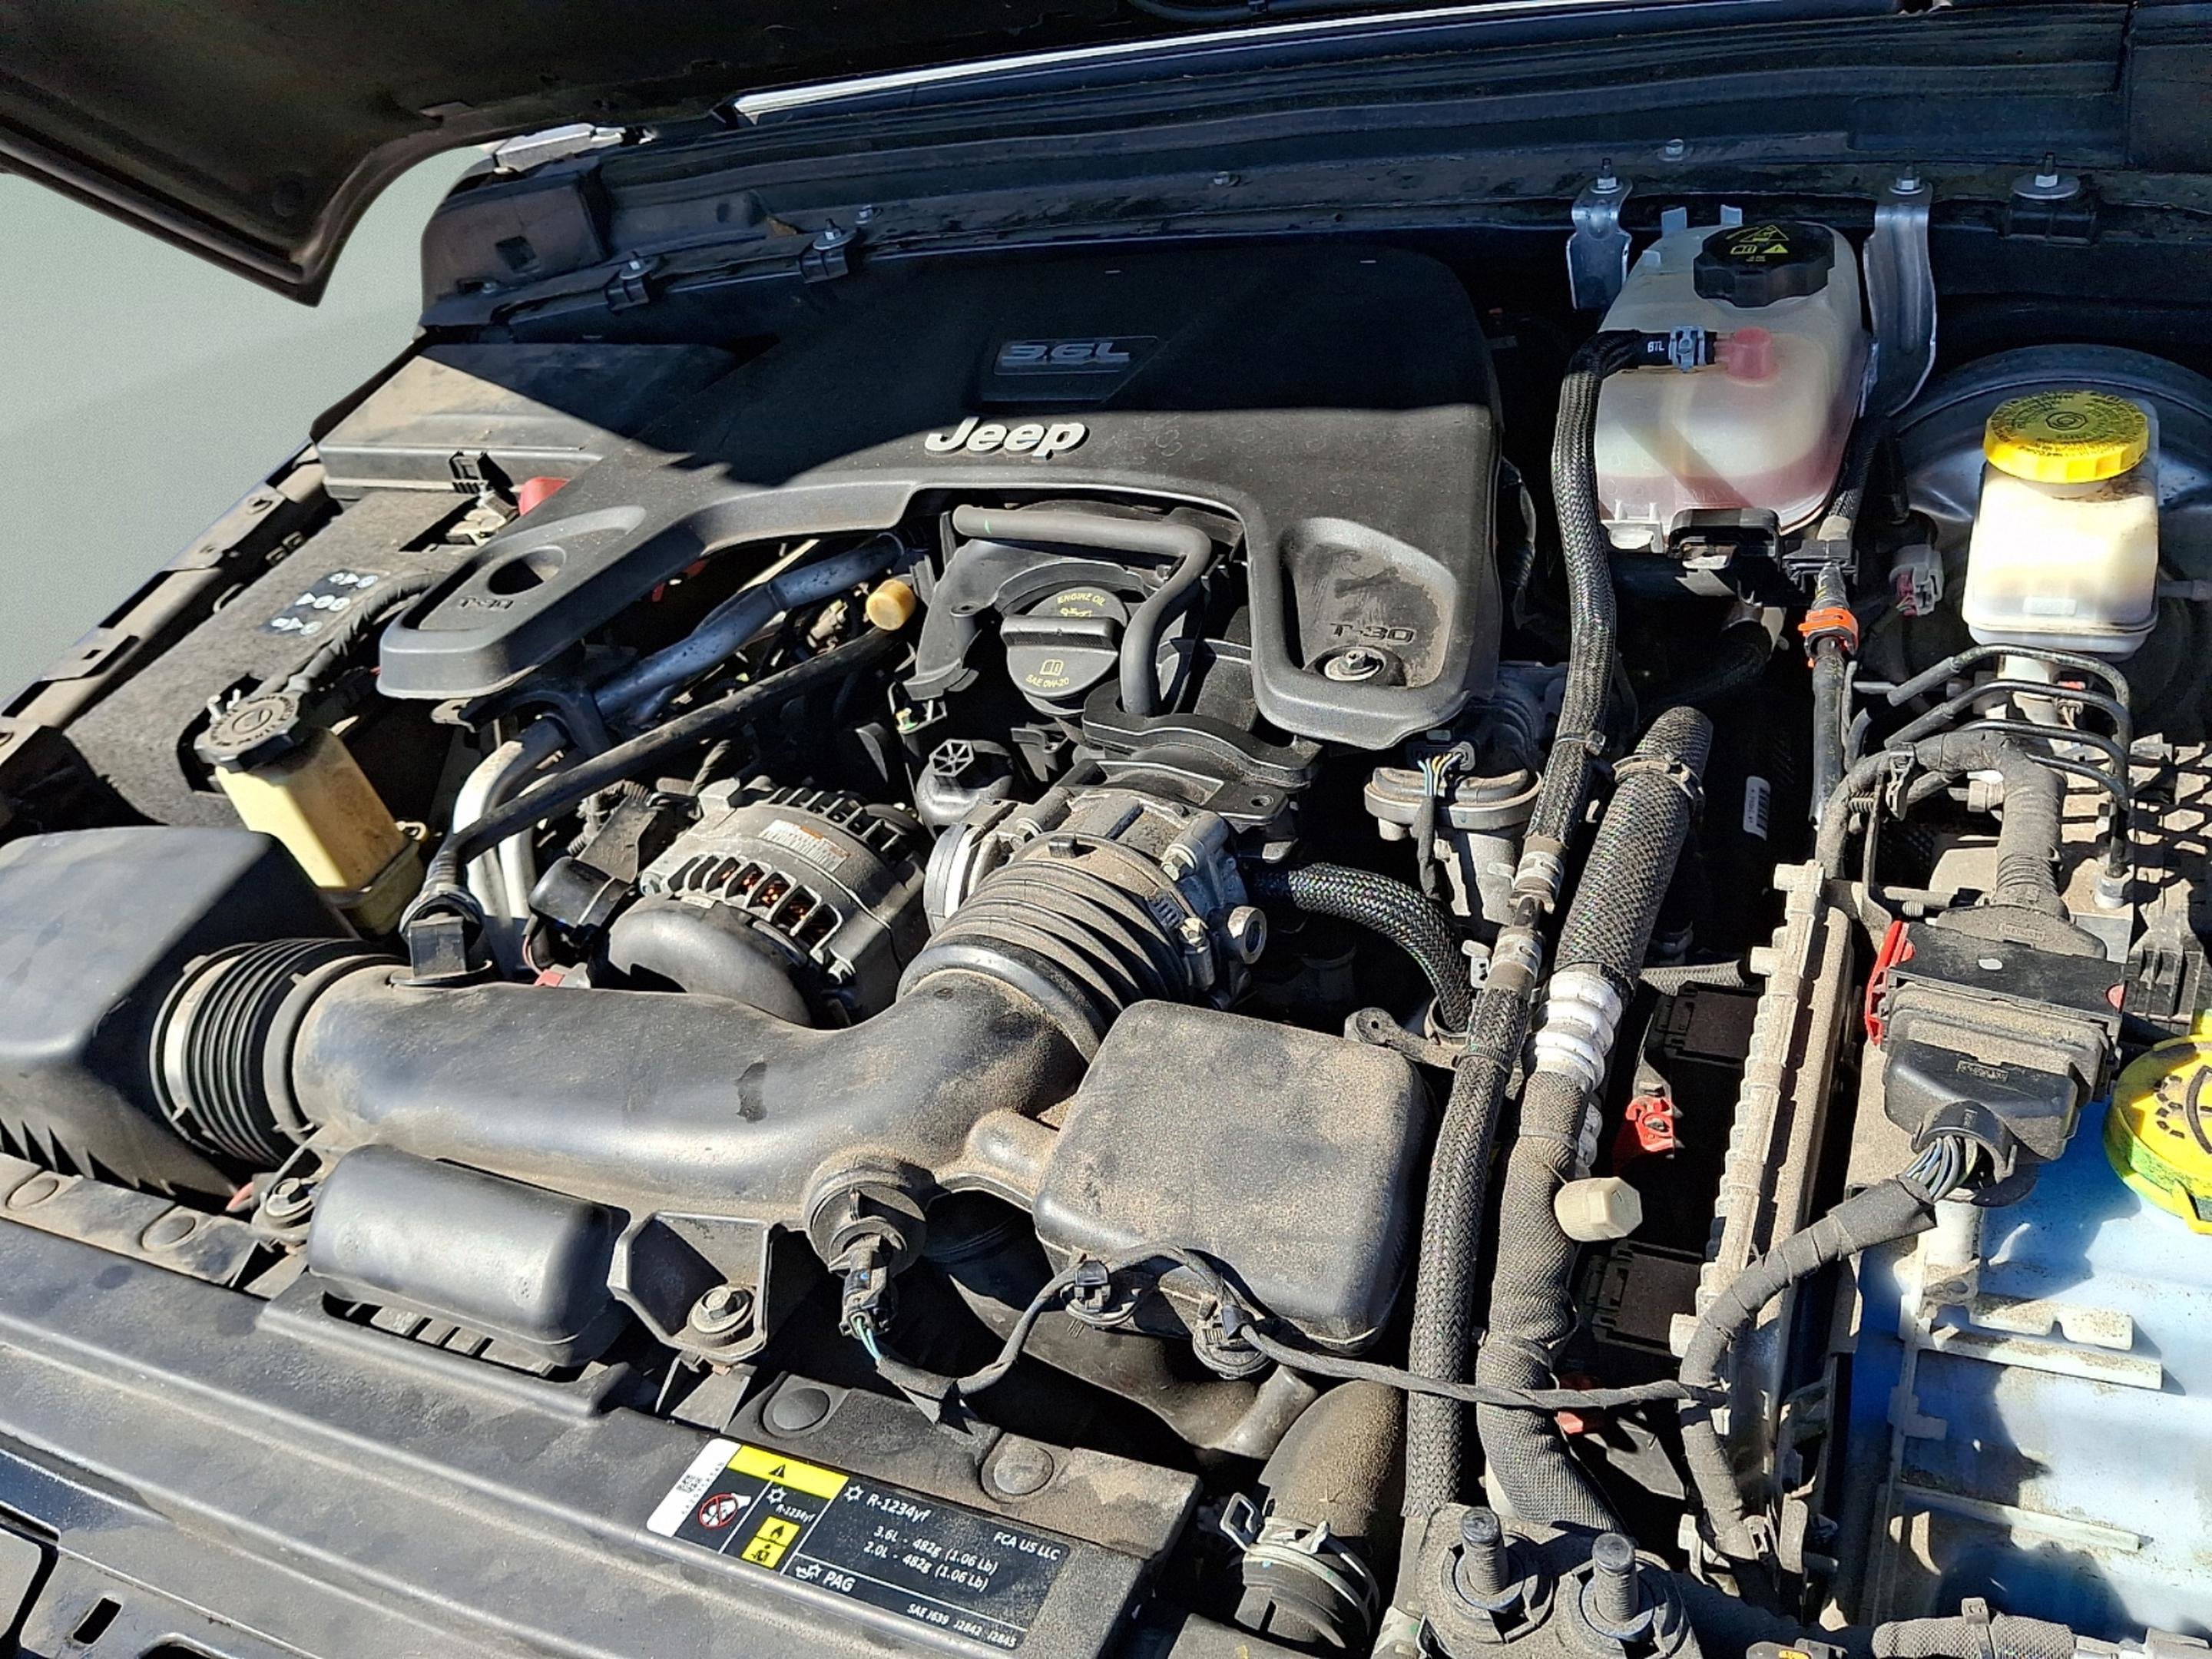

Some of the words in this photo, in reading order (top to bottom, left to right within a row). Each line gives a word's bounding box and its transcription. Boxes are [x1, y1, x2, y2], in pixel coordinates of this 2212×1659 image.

[1001, 341, 1131, 365] 3.6L
[924, 416, 1089, 461] Jeep
[1057, 592, 1090, 605] ENGINE
[1091, 593, 1107, 607] OIL
[1330, 623, 1417, 643] T-30
[1025, 674, 1041, 687] SAE
[1042, 677, 1070, 688] 0W-20
[866, 1493, 932, 1523] R-1234yf
[873, 1525, 898, 1542] 3.6L
[912, 1538, 942, 1558] 482g
[945, 1548, 975, 1568] (1.06
[977, 1556, 998, 1575] Lb)
[993, 1532, 1015, 1548] FCA
[1018, 1537, 1038, 1553] US
[1038, 1544, 1061, 1561] LLC
[823, 1570, 854, 1593] PAG
[863, 1541, 887, 1558] 2.0L
[902, 1553, 932, 1574] 482g
[935, 1563, 966, 1583] (1.06
[967, 1573, 989, 1593] Lb)
[906, 1603, 928, 1618] SAE
[926, 1609, 950, 1625] J639
[953, 1619, 983, 1636] J2842
